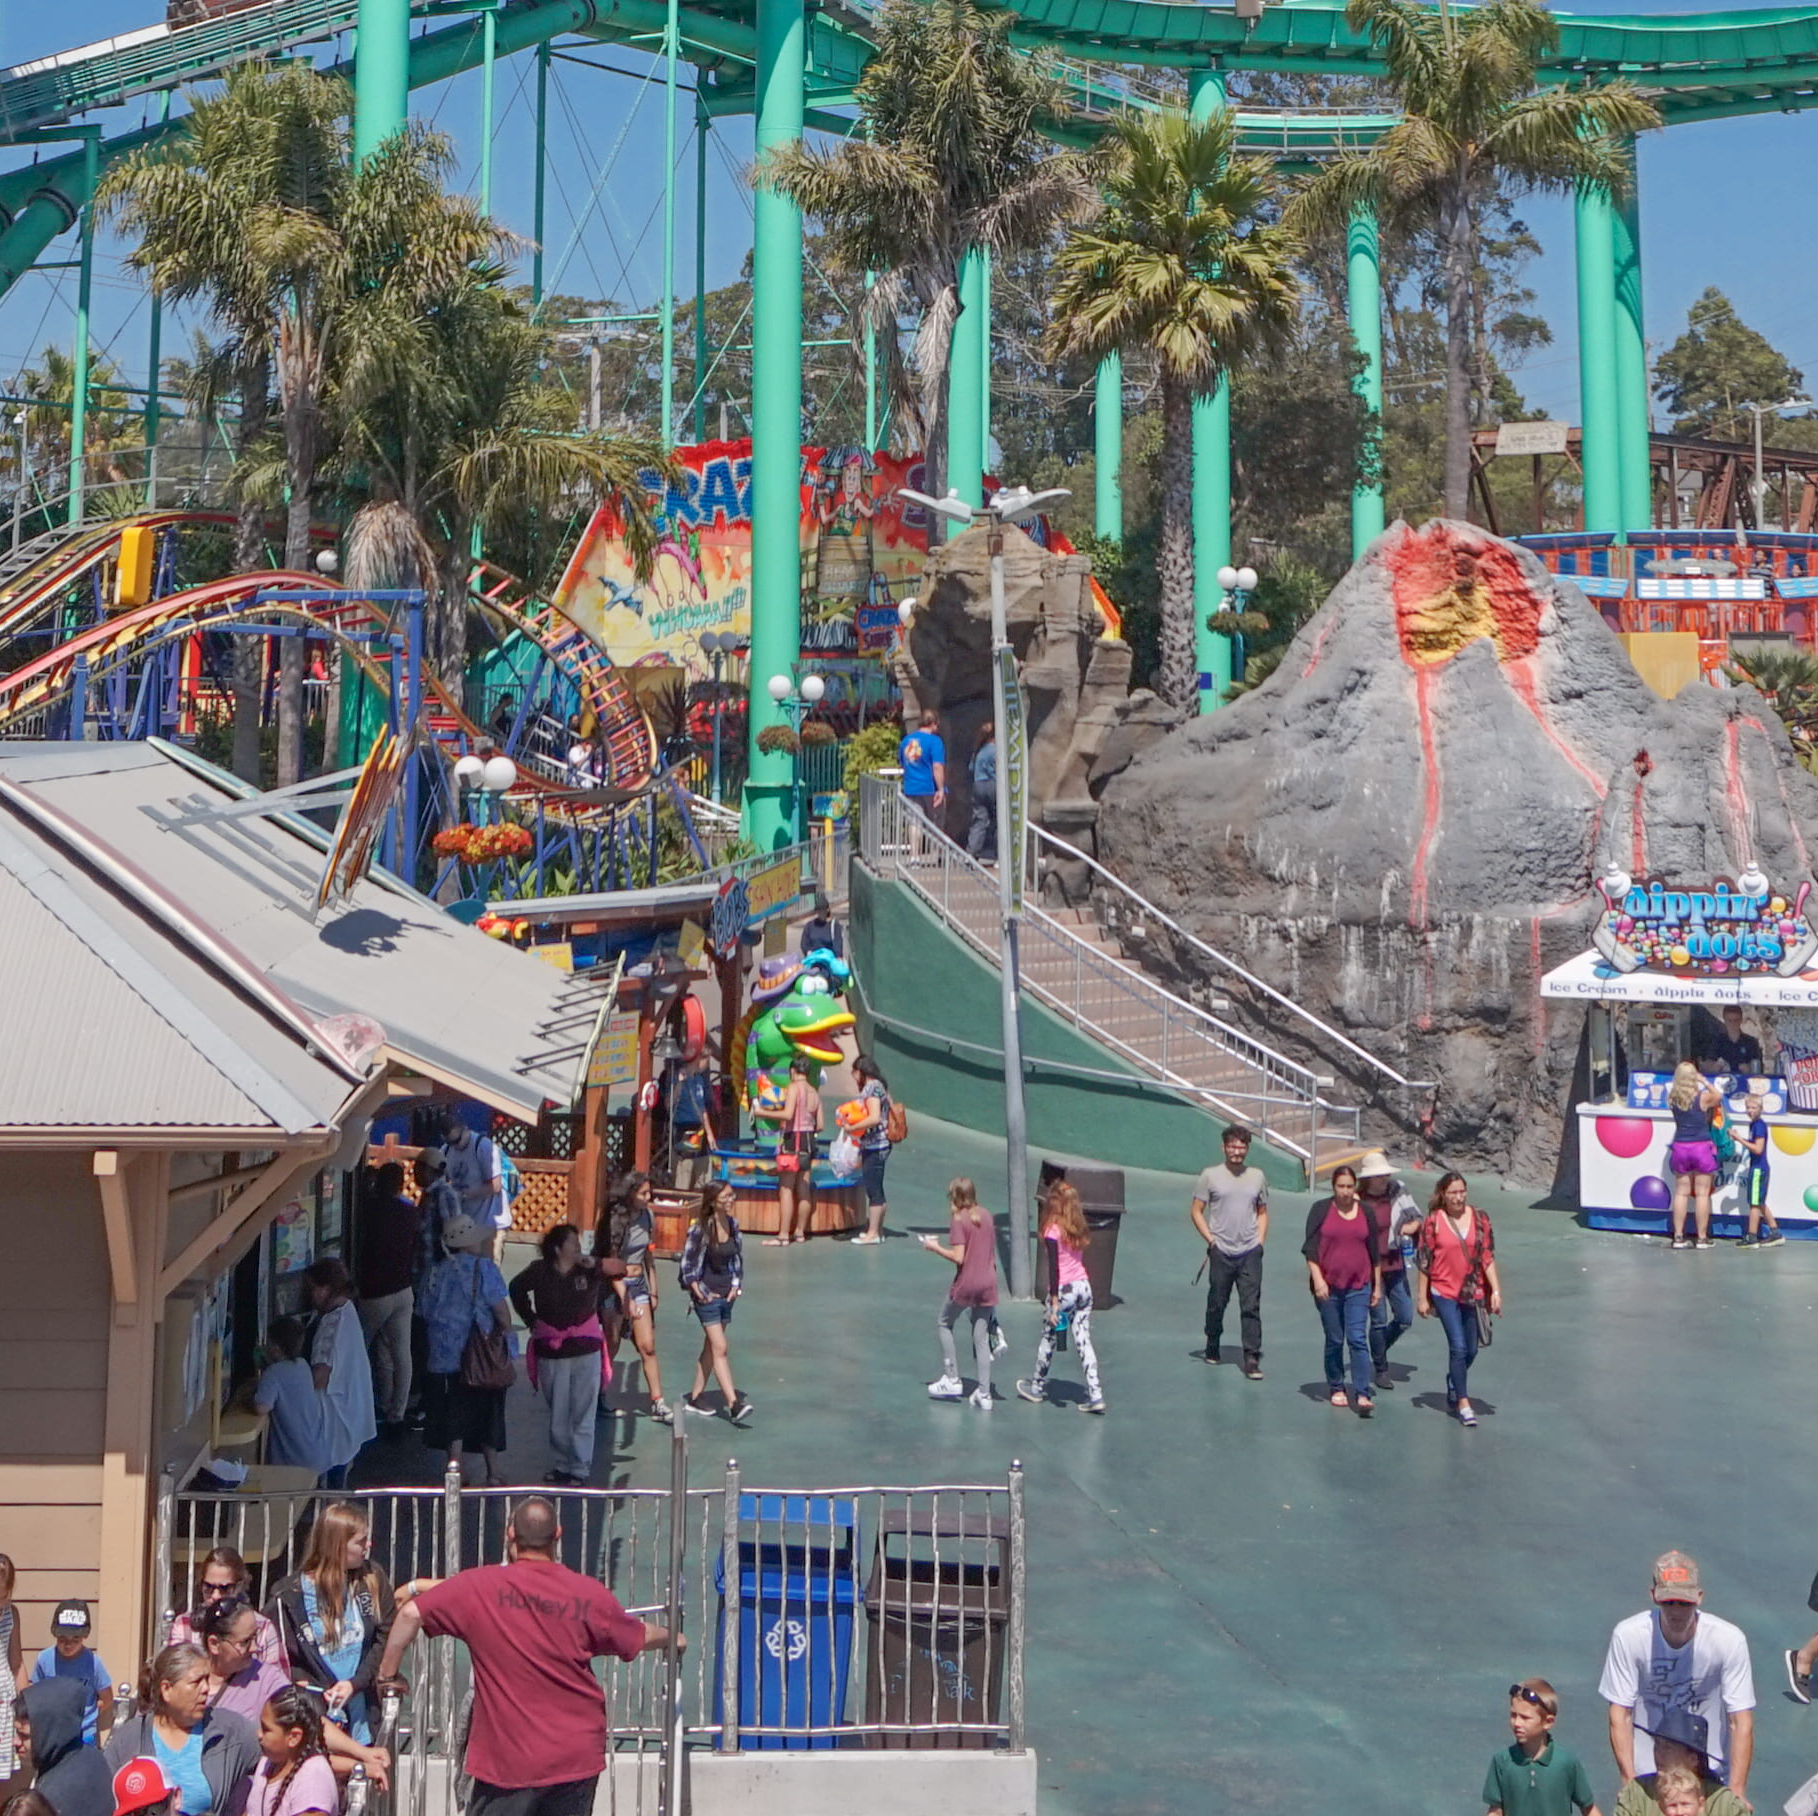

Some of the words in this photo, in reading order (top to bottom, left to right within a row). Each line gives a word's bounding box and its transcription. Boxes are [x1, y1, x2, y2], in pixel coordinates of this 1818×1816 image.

[1686, 926, 1782, 960] dots
[1577, 983, 1628, 996] Cream
[1714, 987, 1752, 1000] dots
[62, 1609, 86, 1617] STAR
